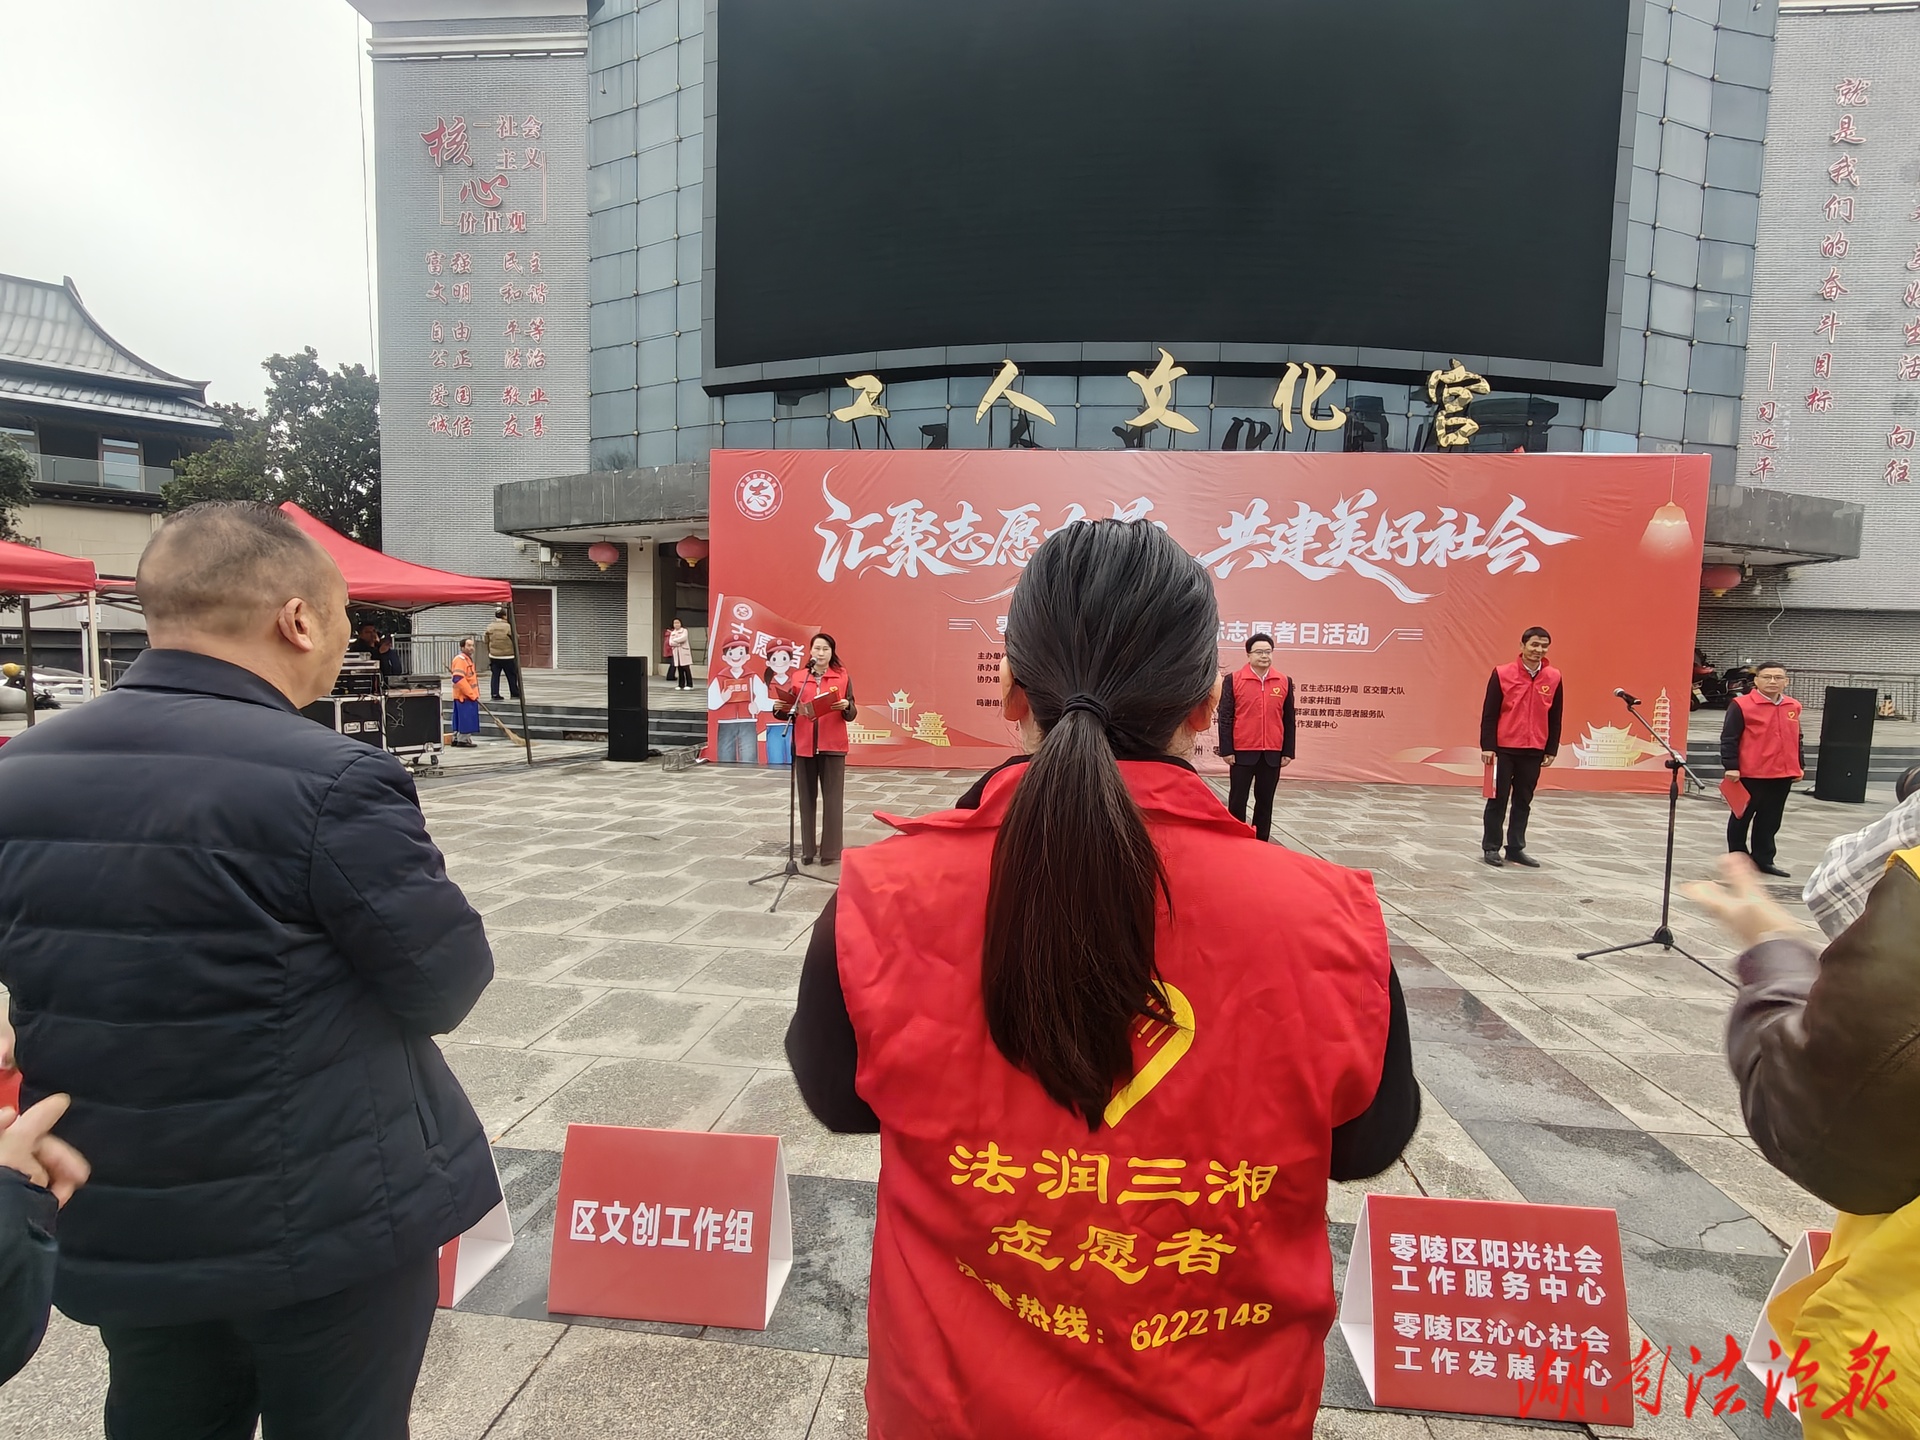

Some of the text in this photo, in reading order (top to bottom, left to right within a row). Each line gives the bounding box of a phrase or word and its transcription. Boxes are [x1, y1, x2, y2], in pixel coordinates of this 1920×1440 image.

[420, 115, 473, 168] 核
[495, 115, 543, 139] 社会
[495, 147, 544, 170] 主义
[458, 173, 509, 208] 心
[458, 210, 528, 234] 价值观
[424, 251, 544, 275] 富强 民主
[1804, 77, 1869, 413] 就是我们的奋斗目标
[426, 281, 548, 305] 文明 和谐
[430, 318, 546, 343] 自由 平等
[429, 348, 546, 370] 公正 法治
[430, 383, 549, 407] 爱国 敬业
[833, 347, 1491, 447] 工人文化宫
[428, 413, 548, 438] 诚信 友善
[1752, 401, 1778, 482] 习近平
[1194, 489, 1584, 604] 共建美好社会
[976, 699, 1003, 707] 鸣谢单
[948, 1141, 1278, 1208] 法润三湘
[570, 1200, 754, 1253] 区文创工作组
[987, 1219, 1237, 1285] 志愿者
[1389, 1233, 1603, 1275] 零陵区阳光社会
[1391, 1265, 1606, 1306] 工作服务中心
[1130, 1302, 1273, 1351] 6222148
[1393, 1312, 1610, 1354] 零陵区沁心社会
[1394, 1345, 1612, 1387] 工作发展中心
